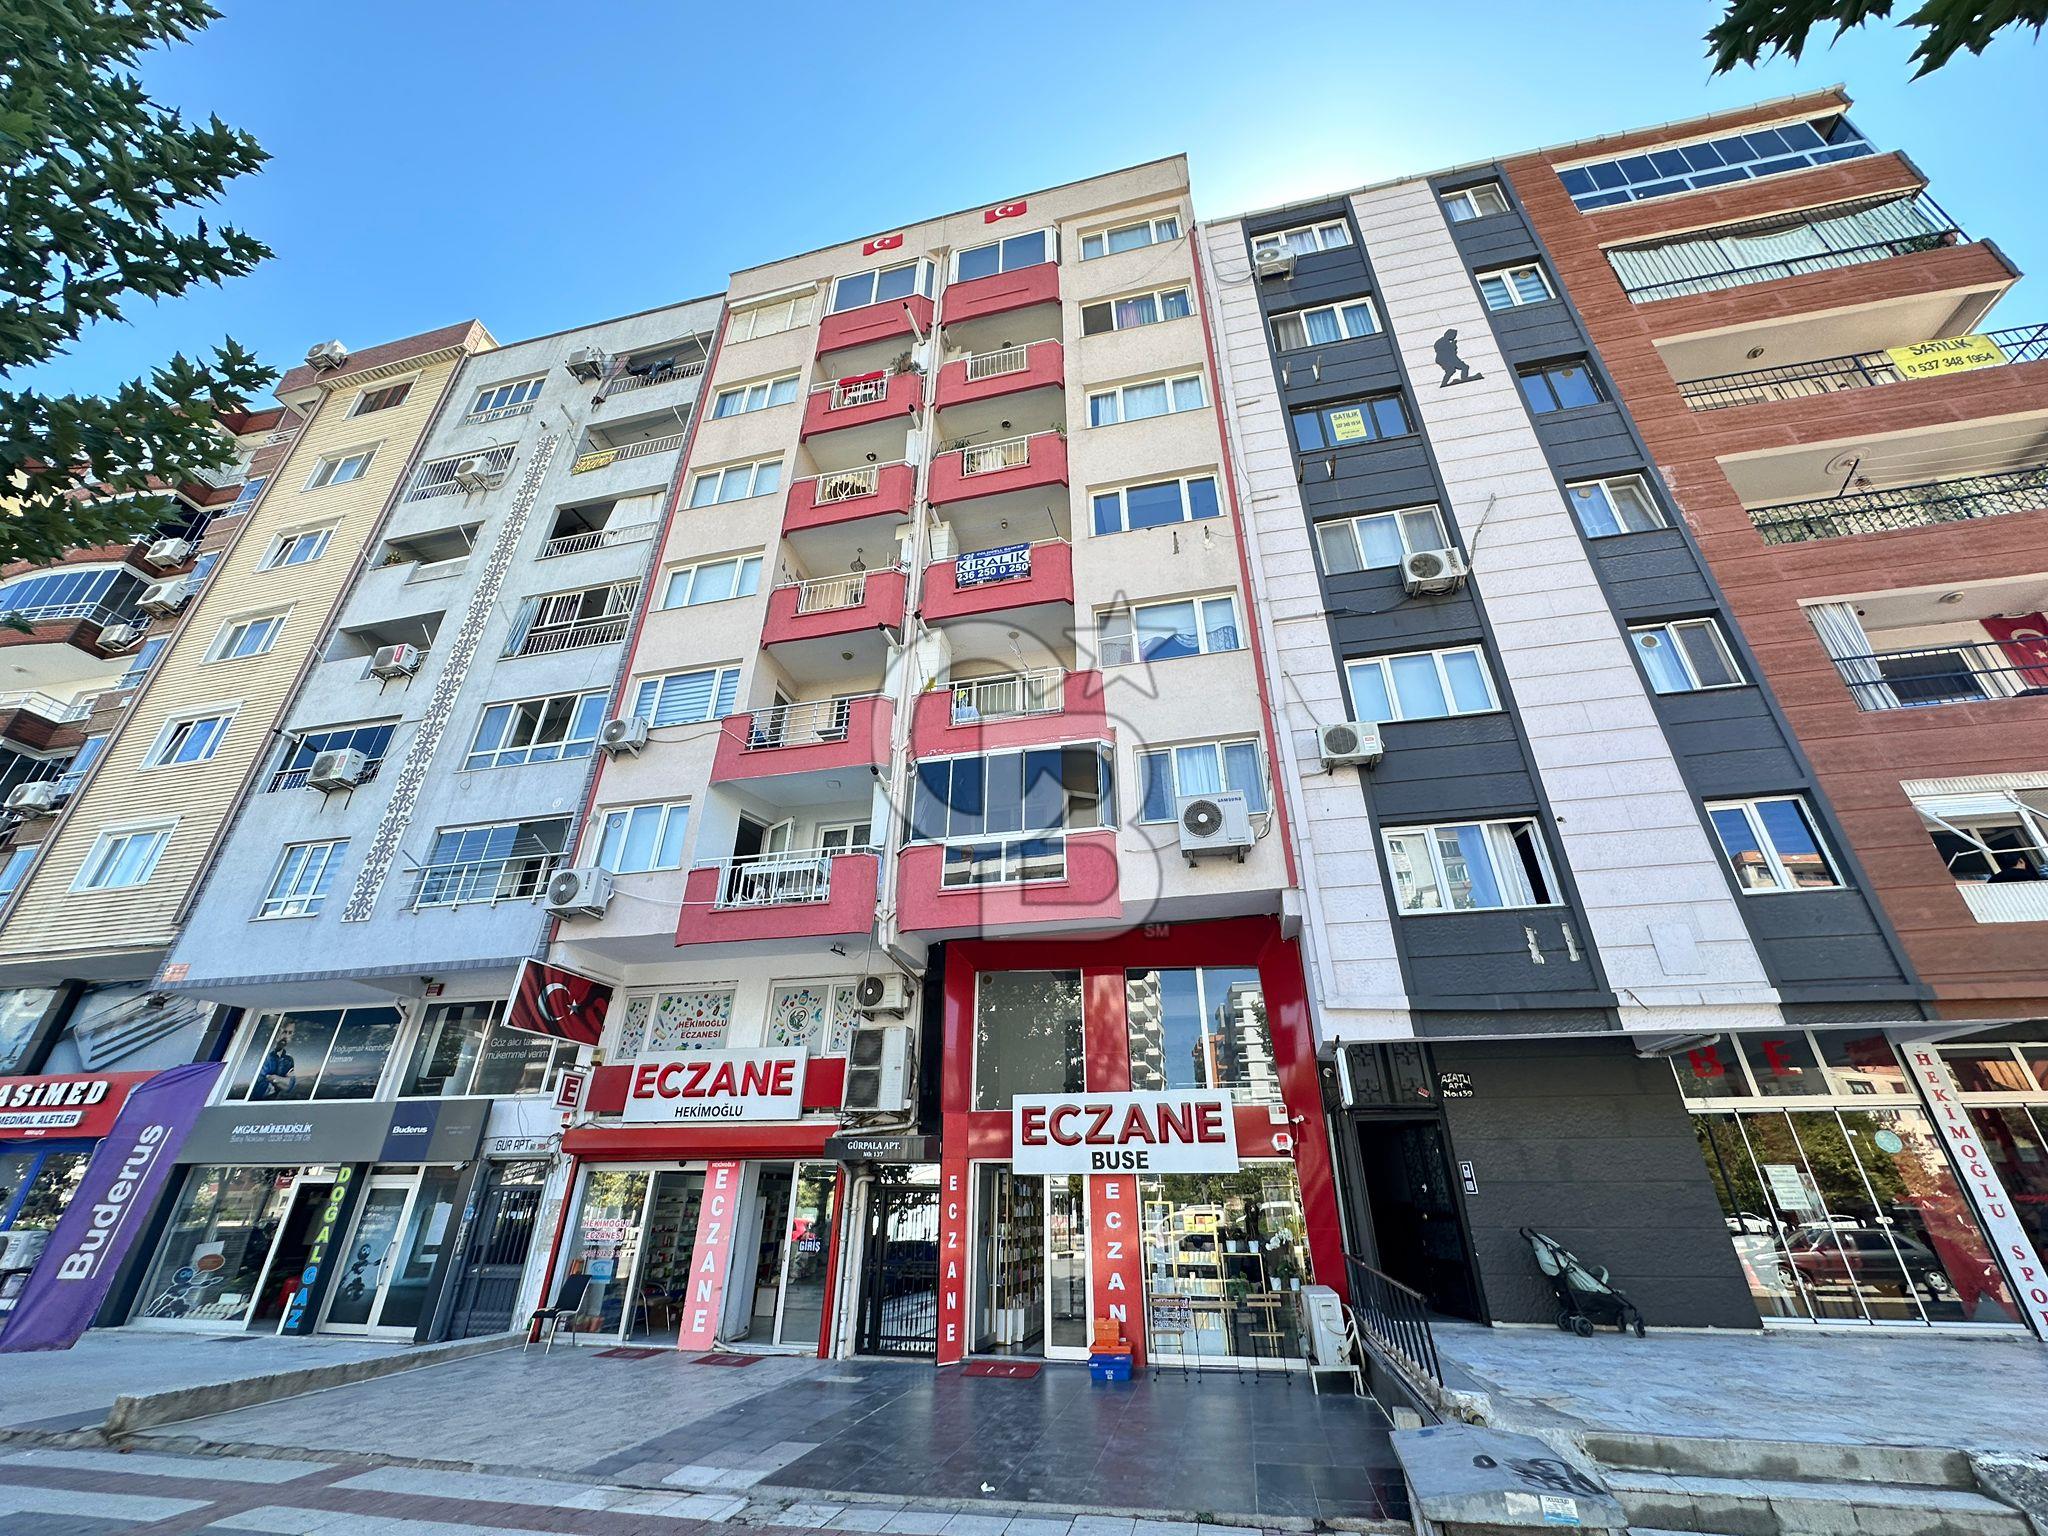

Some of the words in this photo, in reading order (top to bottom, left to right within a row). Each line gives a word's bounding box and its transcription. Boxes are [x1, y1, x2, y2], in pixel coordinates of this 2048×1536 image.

[1908, 339, 1973, 356] SATILIK
[1907, 365, 1917, 374] 0
[1918, 359, 1939, 372] 537
[1942, 356, 1964, 368] 348
[1965, 352, 1995, 364] 1954
[956, 571, 975, 582] 236
[977, 566, 996, 578] 250
[999, 565, 1006, 574] 0
[1008, 562, 1029, 573] 250
[561, 1077, 580, 1103] E
[632, 1059, 796, 1099] ECZANE
[36, 1114, 78, 1125] ALETLER
[674, 1103, 744, 1118] HEKİMOĞLU
[392, 1125, 428, 1134] Buderus
[1021, 1101, 1226, 1147] ECZANE
[1914, 1052, 2008, 1219] HEKİMOĞLU
[847, 1140, 883, 1150] GÜRPALA
[883, 1140, 902, 1150] APT.
[1091, 1150, 1150, 1170] BUSE
[56, 1125, 164, 1280] Buderus
[309, 1166, 351, 1264] DOĞAL
[692, 1168, 729, 1334] ECZANE
[799, 1239, 821, 1253] GİRİŞ
[946, 1175, 958, 1342] ECZANE
[1105, 1182, 1127, 1343] ECZAN
[285, 1265, 318, 1329] GAZ
